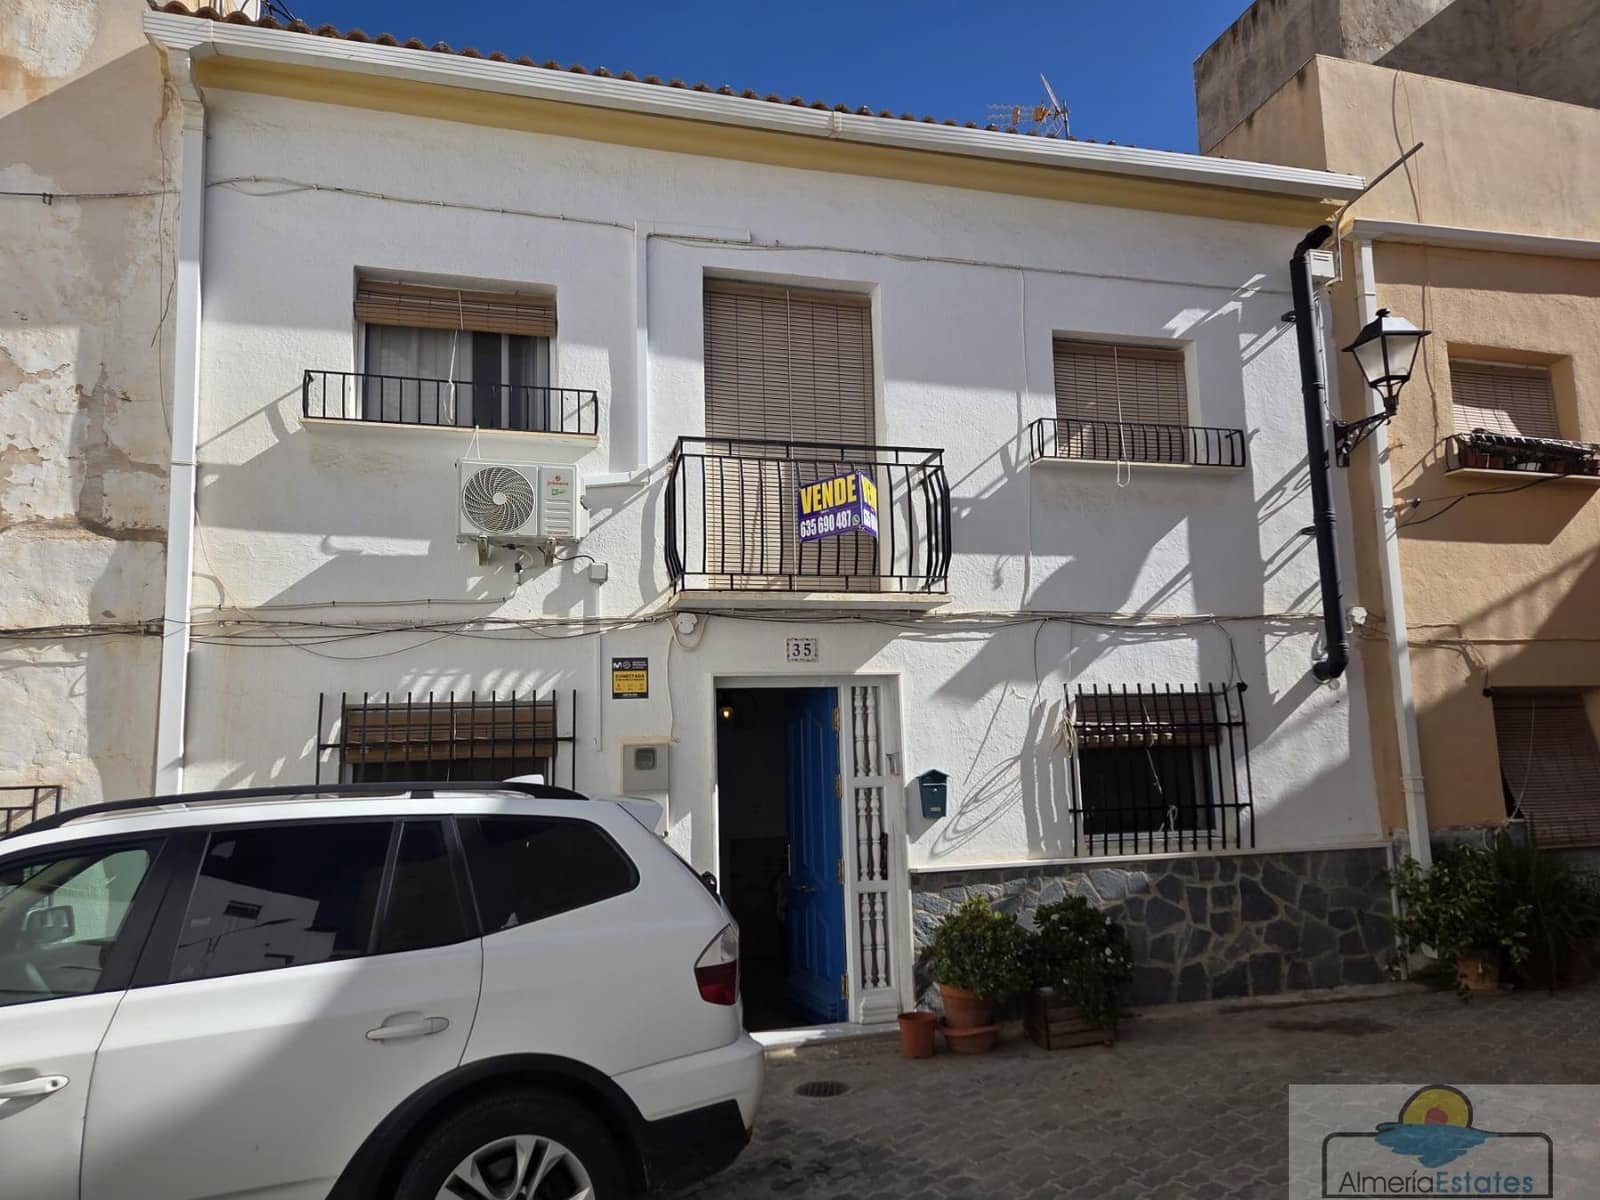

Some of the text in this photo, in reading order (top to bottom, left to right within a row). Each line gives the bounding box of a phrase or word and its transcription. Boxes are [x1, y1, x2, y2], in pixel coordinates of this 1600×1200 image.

[800, 474, 857, 514] VENDE
[800, 518, 817, 538] 635
[818, 514, 835, 534] 690
[836, 509, 852, 530] 487
[792, 643, 812, 657] 35
